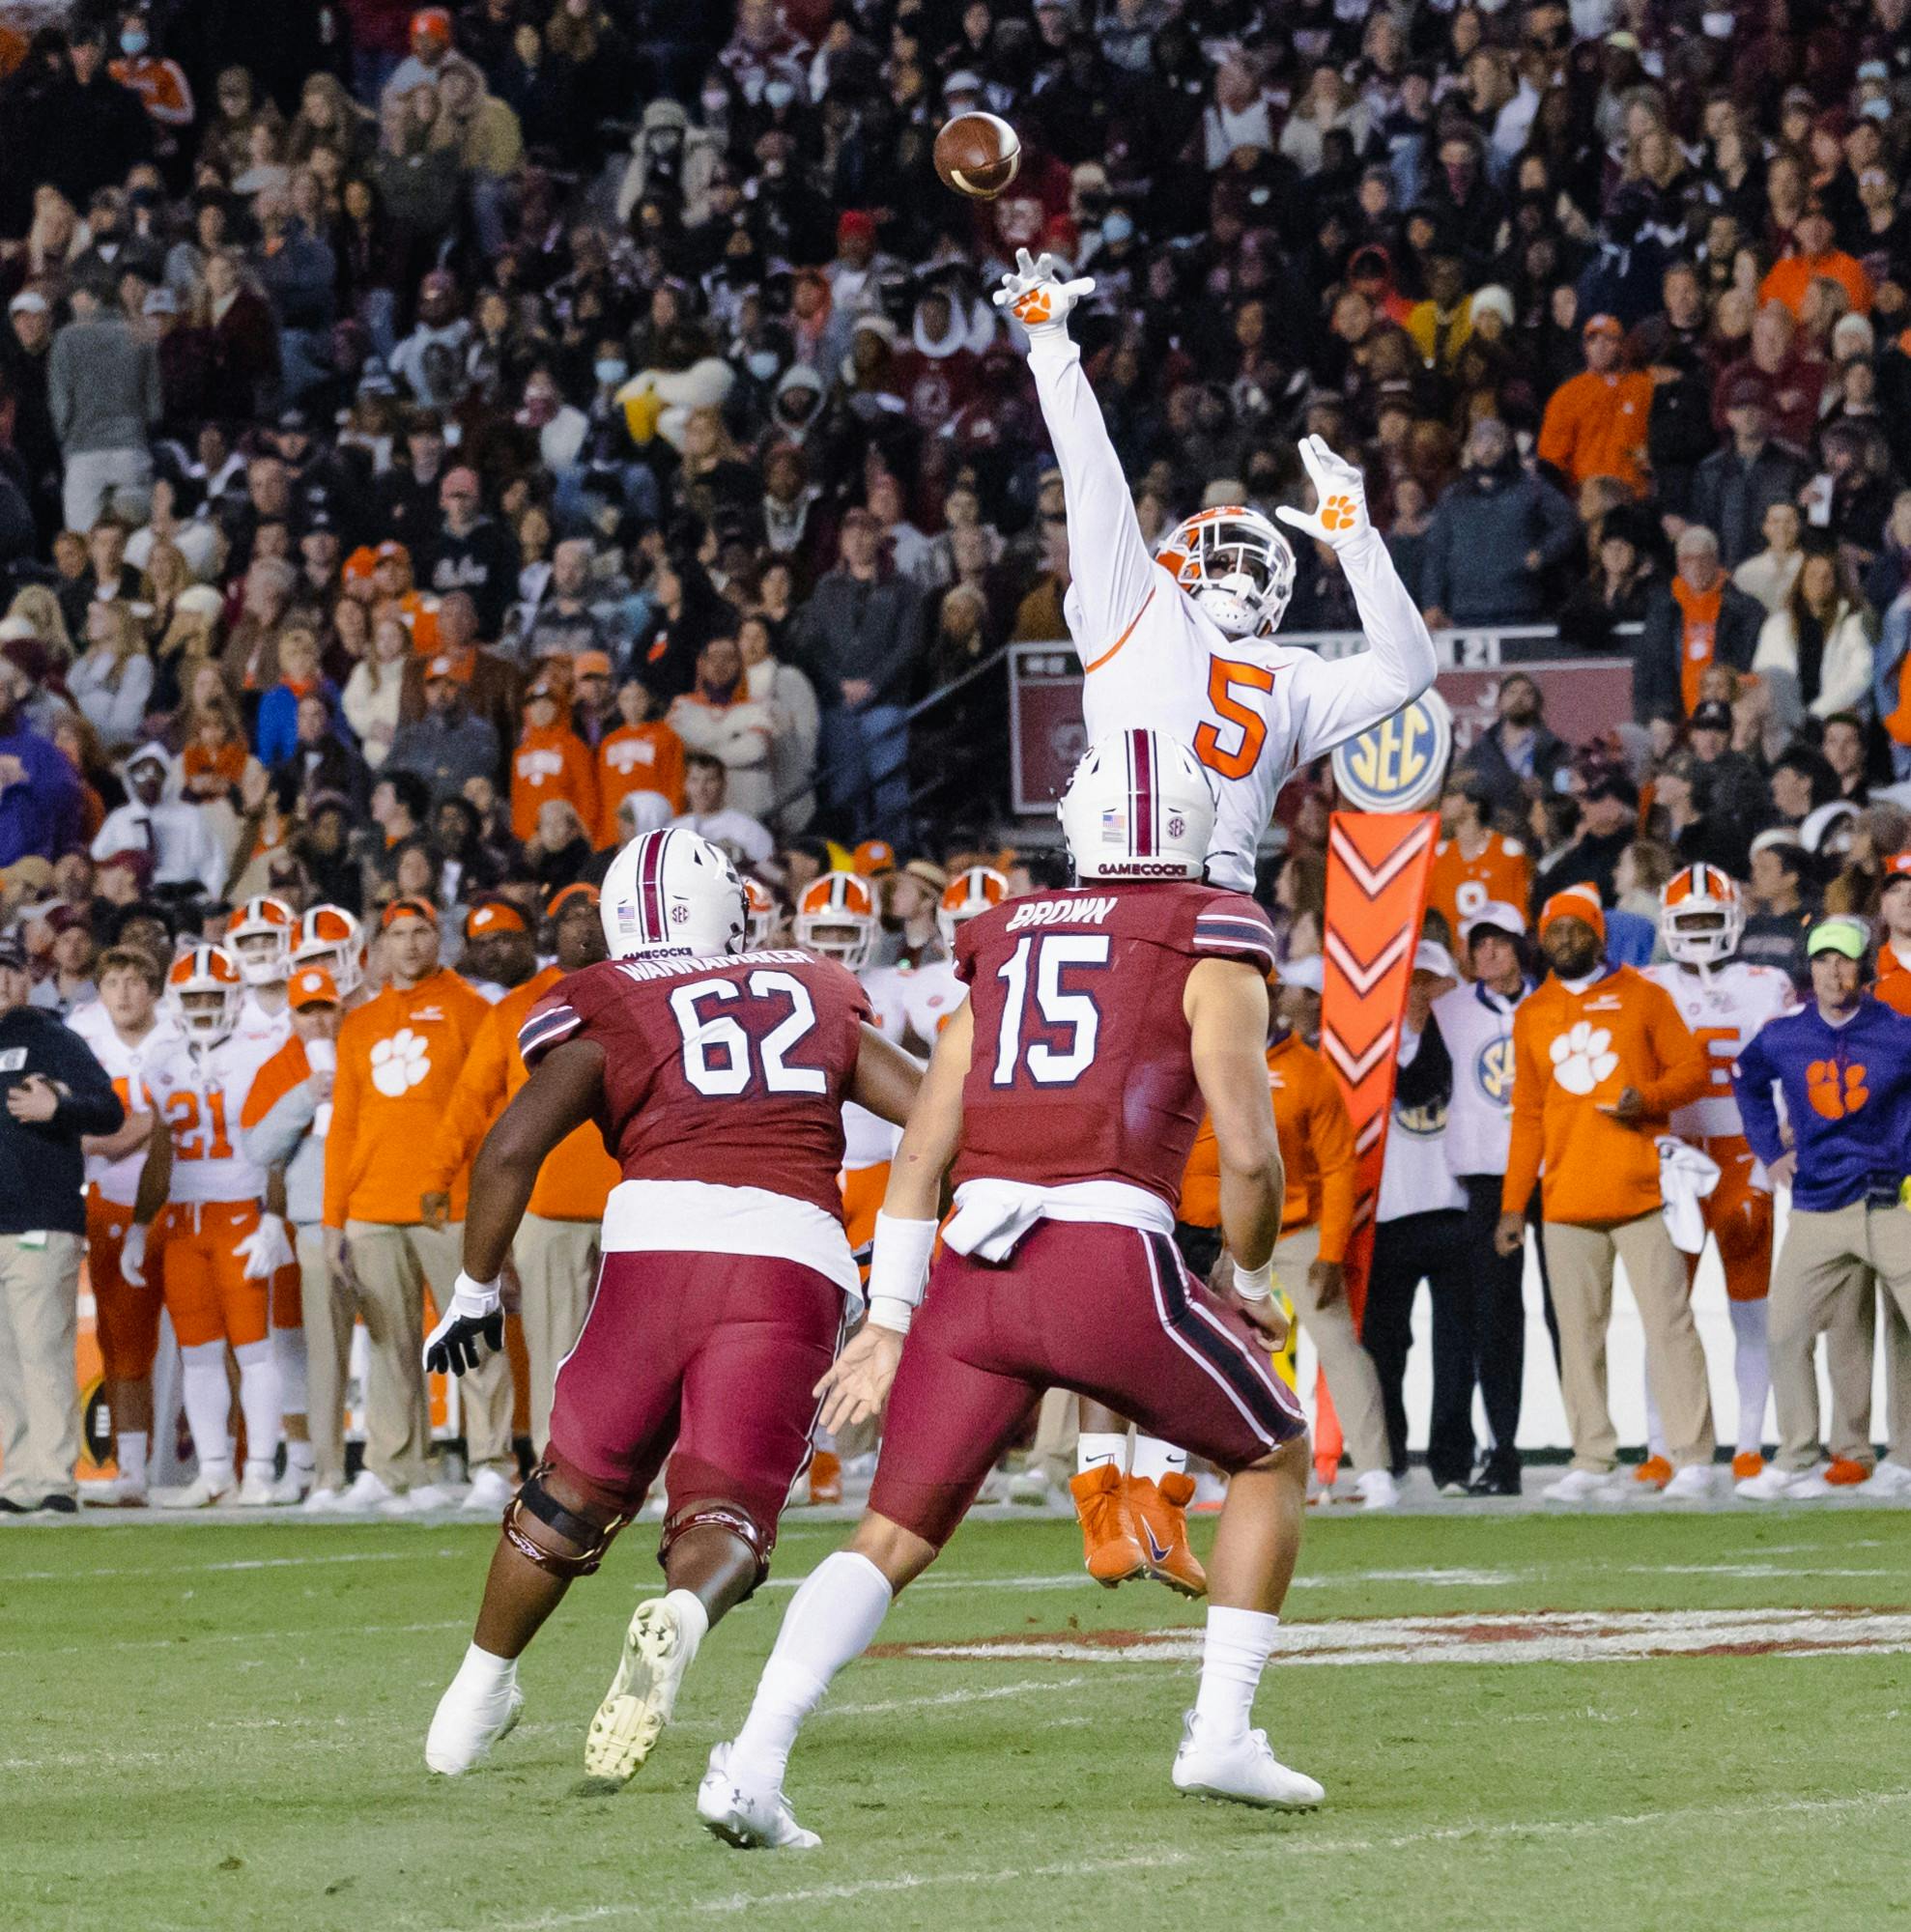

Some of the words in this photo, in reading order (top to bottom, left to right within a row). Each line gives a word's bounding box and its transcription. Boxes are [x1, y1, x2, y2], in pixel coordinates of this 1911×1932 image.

[1191, 651, 1276, 781] 5
[1350, 704, 1430, 792] SEC
[1005, 896, 1119, 932] BROWN
[614, 950, 816, 982] WANNAMAKER
[667, 969, 828, 1096] 62
[990, 932, 1114, 1091] 15
[165, 1089, 234, 1161] 21
